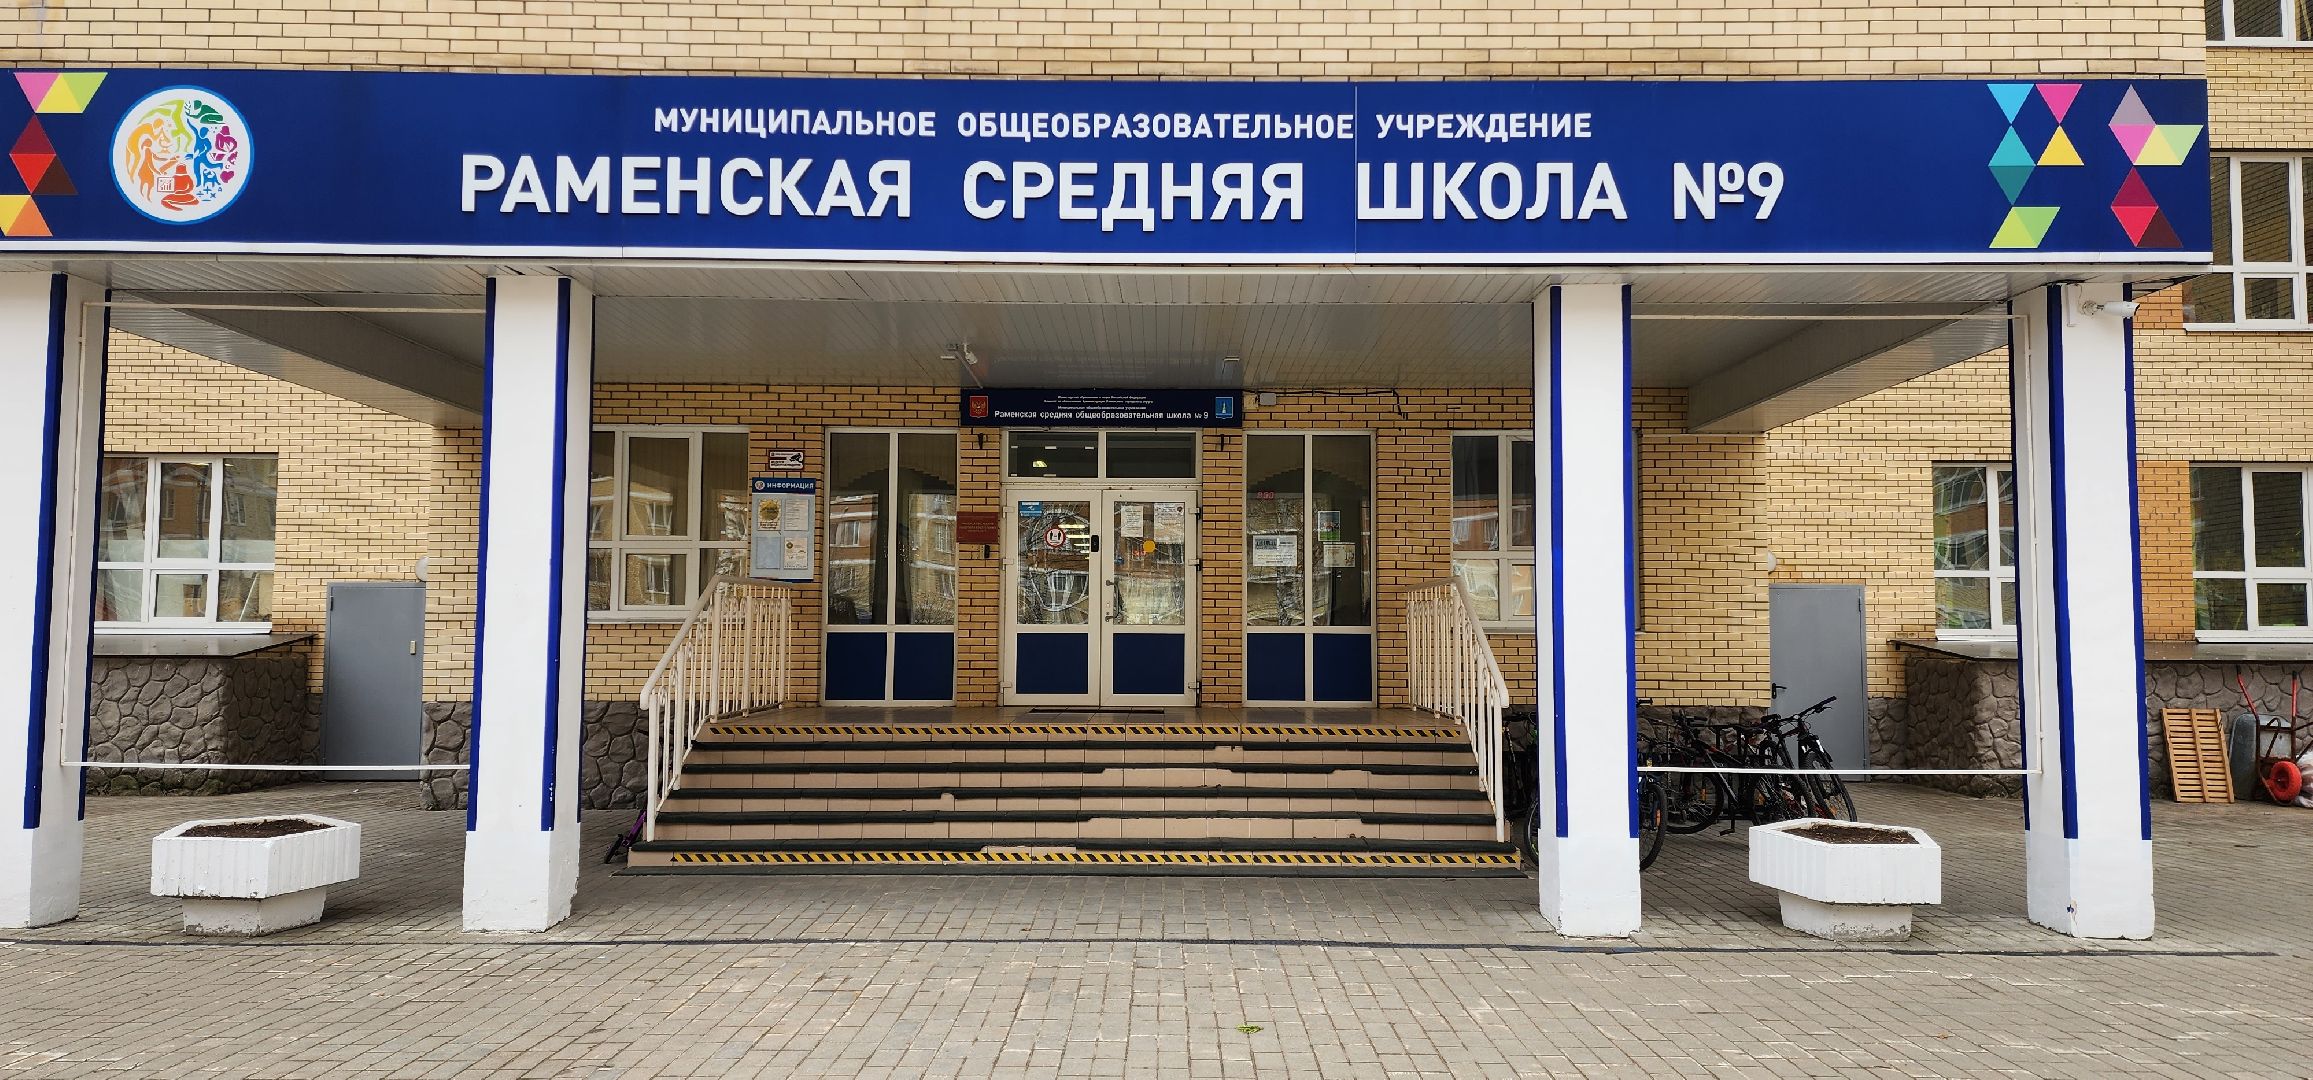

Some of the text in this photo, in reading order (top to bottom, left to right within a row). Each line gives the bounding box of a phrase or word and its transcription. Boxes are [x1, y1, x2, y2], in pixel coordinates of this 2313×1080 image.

[654, 108, 1592, 142] МУНИЦИПАЛЬНОЕ ОБЩЕОБРАЗОВАТЕЛЬНОЕ УЧРЕЖДЕНИЕ
[461, 155, 1784, 232] РАМЕНСКАЯ СРЕДНЯЯ ШКОЛА №9
[994, 410, 1037, 419] Раменская
[1039, 411, 1073, 420] средняя
[1075, 410, 1164, 420] общеобразовательная
[766, 482, 814, 490] ИНФОРМАЦИЯ
